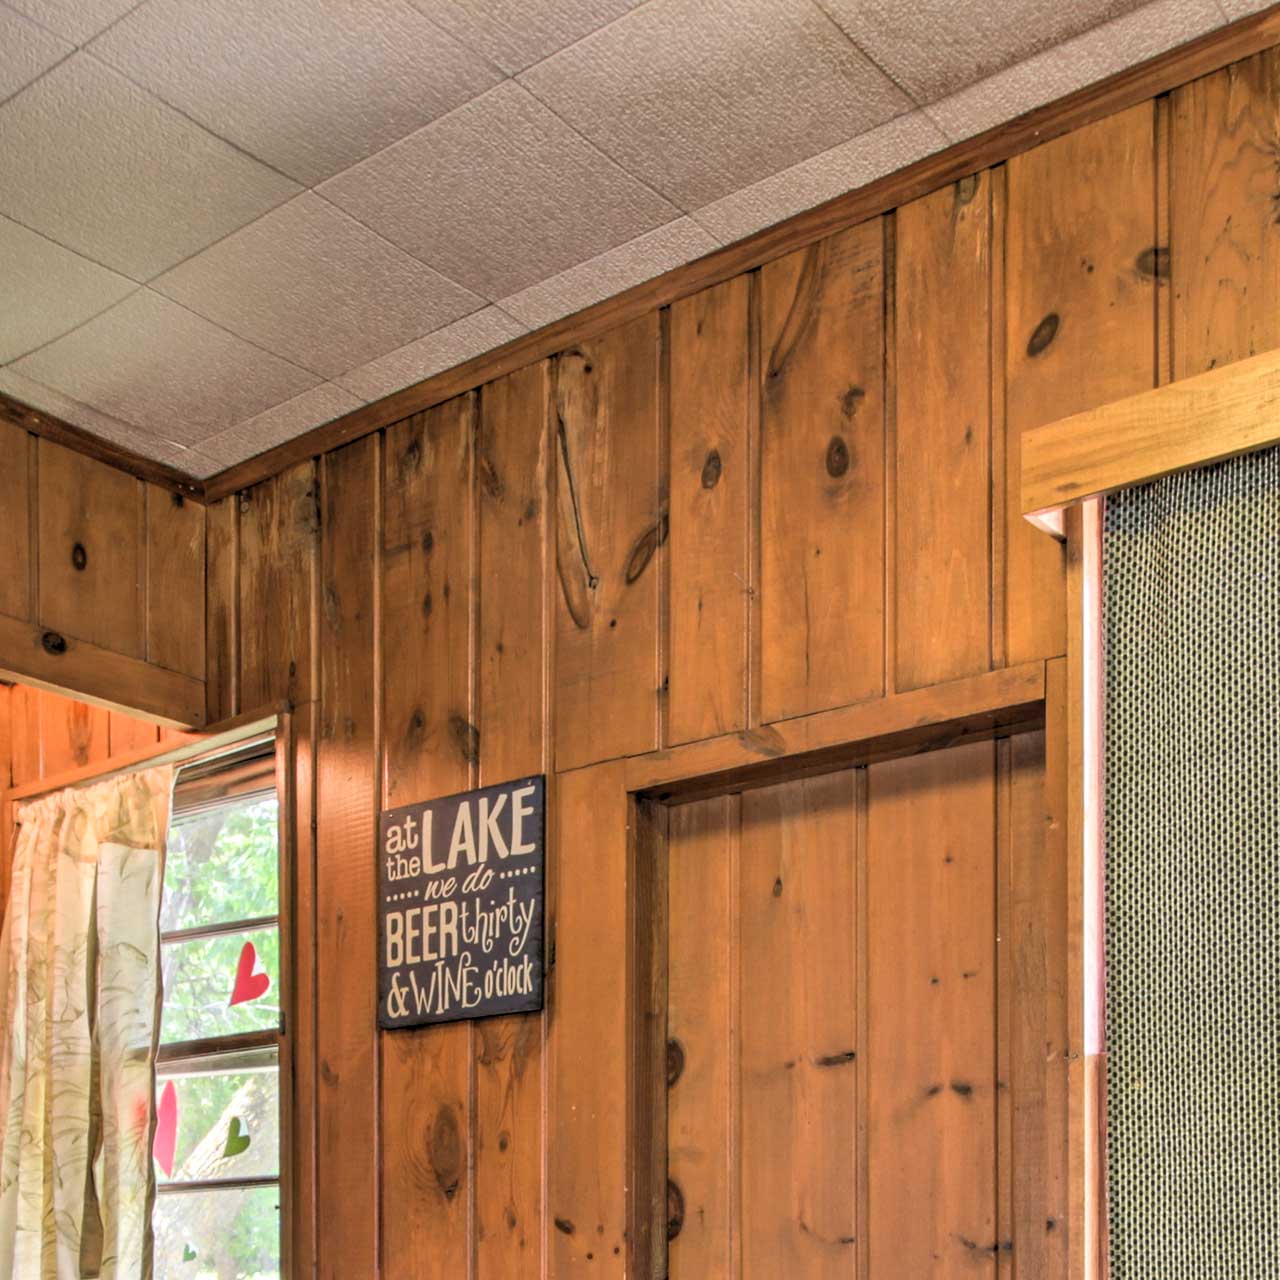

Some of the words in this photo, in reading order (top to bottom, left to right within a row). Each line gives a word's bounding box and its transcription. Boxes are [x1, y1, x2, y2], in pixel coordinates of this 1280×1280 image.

[386, 816, 418, 854] at
[422, 784, 536, 875] LAKE
[386, 854, 421, 882] the
[425, 879, 457, 900] we
[462, 864, 495, 894] do
[386, 901, 458, 968] BEER
[459, 887, 536, 956] thirty
[387, 972, 409, 1018] &
[409, 951, 481, 1015] WINE
[485, 954, 534, 1000] o'clock
